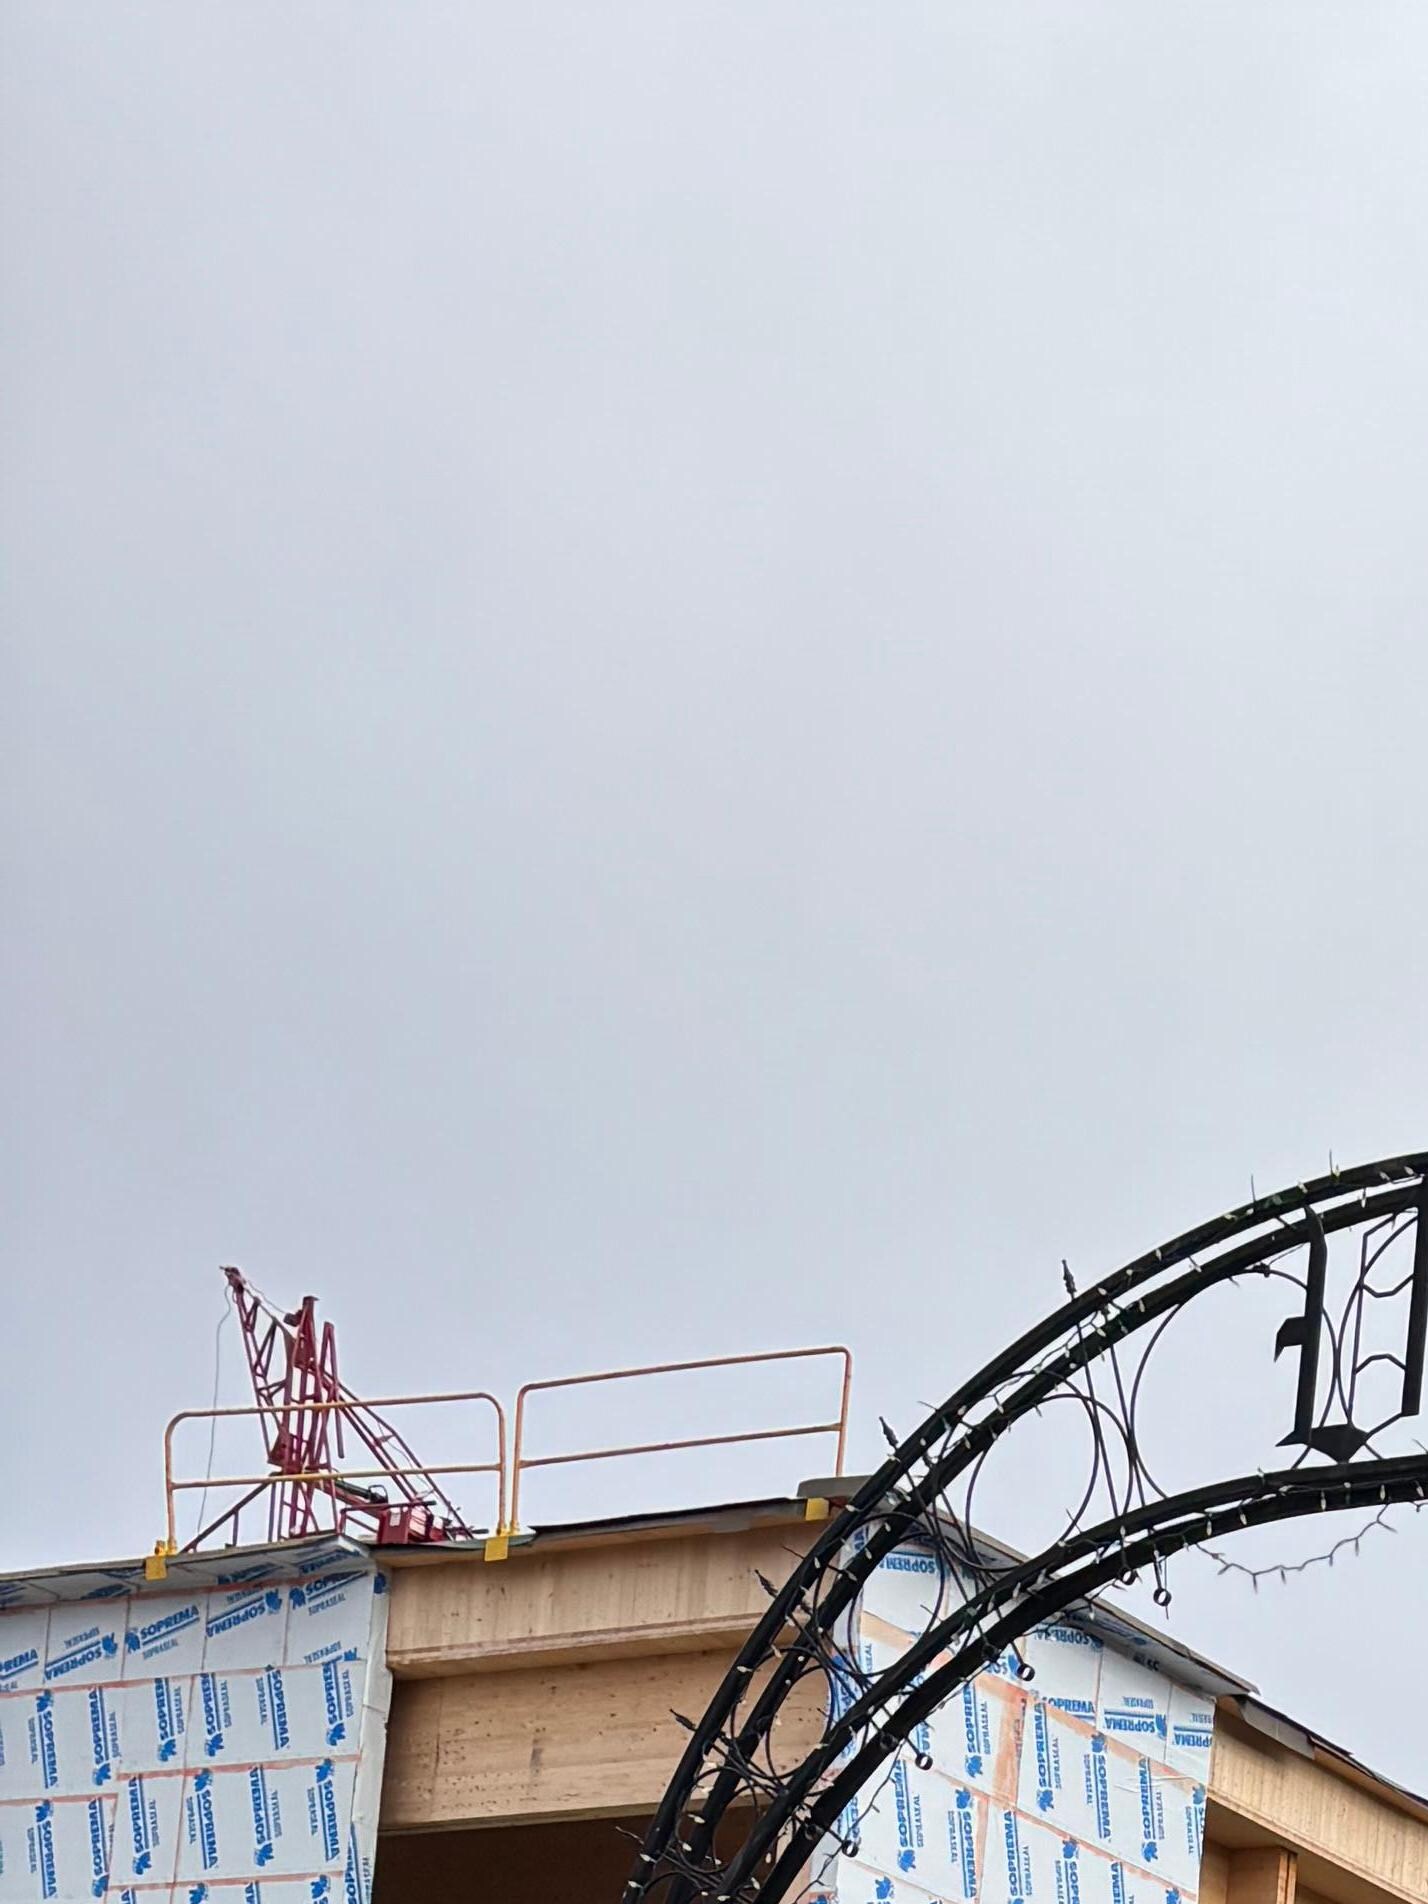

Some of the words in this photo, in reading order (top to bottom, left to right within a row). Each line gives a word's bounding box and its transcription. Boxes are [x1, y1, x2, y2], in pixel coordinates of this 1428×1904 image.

[140, 1605, 199, 1640] SOPREMA
[206, 1602, 266, 1638] SOPREMA
[44, 1650, 101, 1680] SOPREMA
[89, 1690, 105, 1764] SOPREMA
[271, 1670, 290, 1747] SOPREMA
[1035, 1702, 1047, 1788] SOPREMA
[1106, 1718, 1155, 1733] SOPREMA
[43, 1711, 58, 1786] SOPREMA
[129, 1777, 144, 1853] SOPREMA
[200, 1790, 218, 1868] SOPREMA
[250, 1767, 265, 1844] SOPREMA
[323, 1780, 340, 1860] SOPREMA
[1099, 1755, 1111, 1838] SOPREMA
[42, 1820, 57, 1897] SOPREMA
[89, 1800, 102, 1876] SOPREMA
[963, 1812, 976, 1898] SOPREMA
[1003, 1811, 1017, 1896] SOPREMA
